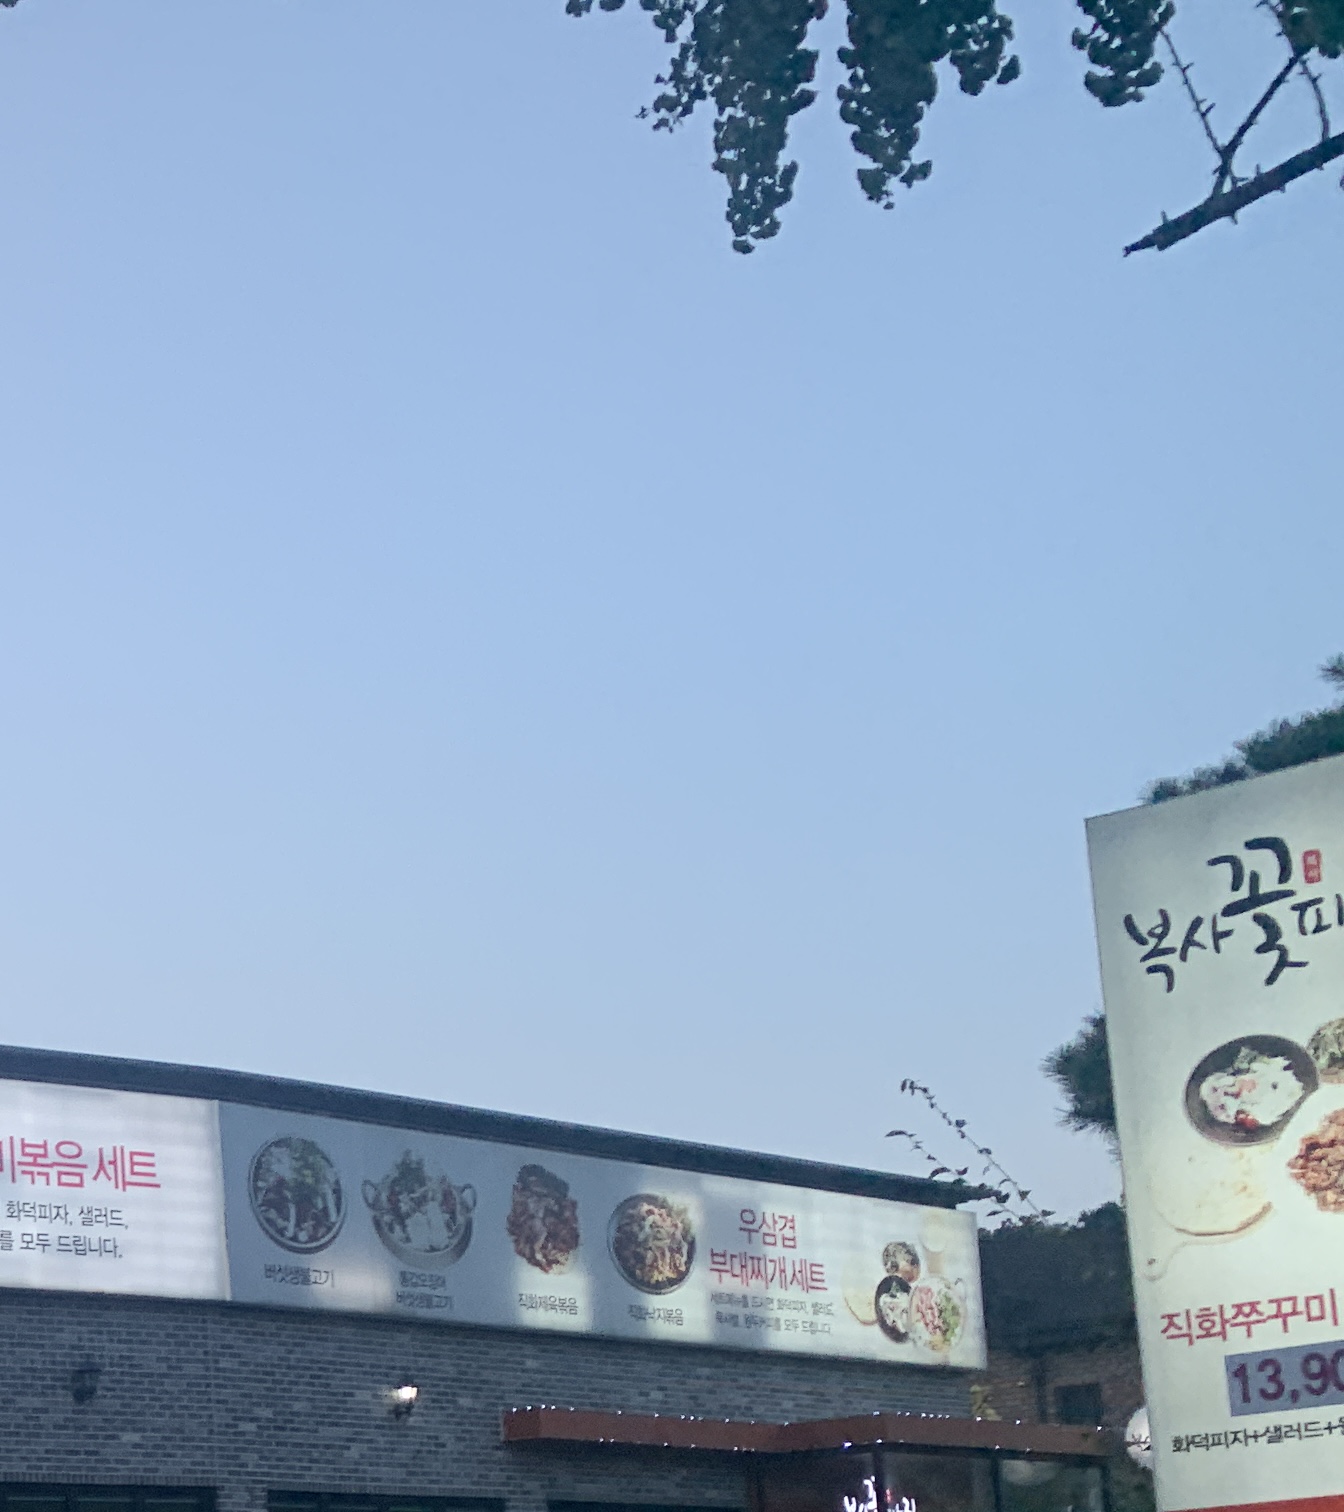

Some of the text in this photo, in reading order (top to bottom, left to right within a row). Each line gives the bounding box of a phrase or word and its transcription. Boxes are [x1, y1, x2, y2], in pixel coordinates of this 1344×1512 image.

[6, 1200, 73, 1226] 화덕피자,
[78, 1205, 129, 1230] 샐러드,
[739, 1208, 797, 1250] 우삼겹
[19, 1232, 52, 1255] 모두
[56, 1234, 123, 1259] 드립니다.
[1160, 1288, 1339, 1347] 직화쭈꾸미
